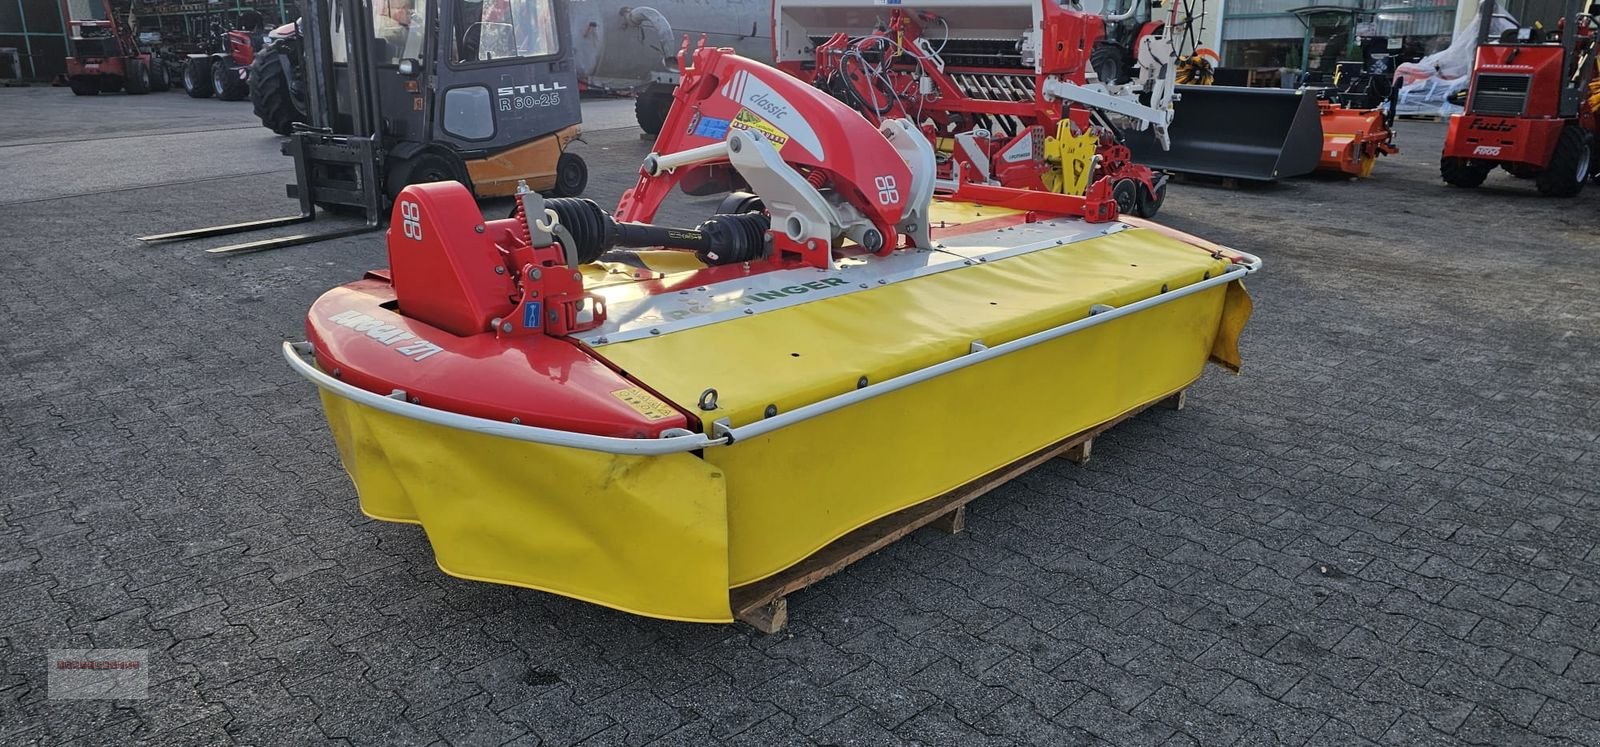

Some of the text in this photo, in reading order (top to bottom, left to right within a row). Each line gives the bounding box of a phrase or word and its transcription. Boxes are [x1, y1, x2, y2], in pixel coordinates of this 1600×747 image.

[498, 82, 567, 96] STILL
[499, 92, 560, 111] R 60-25
[749, 93, 787, 119] classic
[1469, 118, 1517, 132] Fuchs
[394, 339, 444, 362] 271
